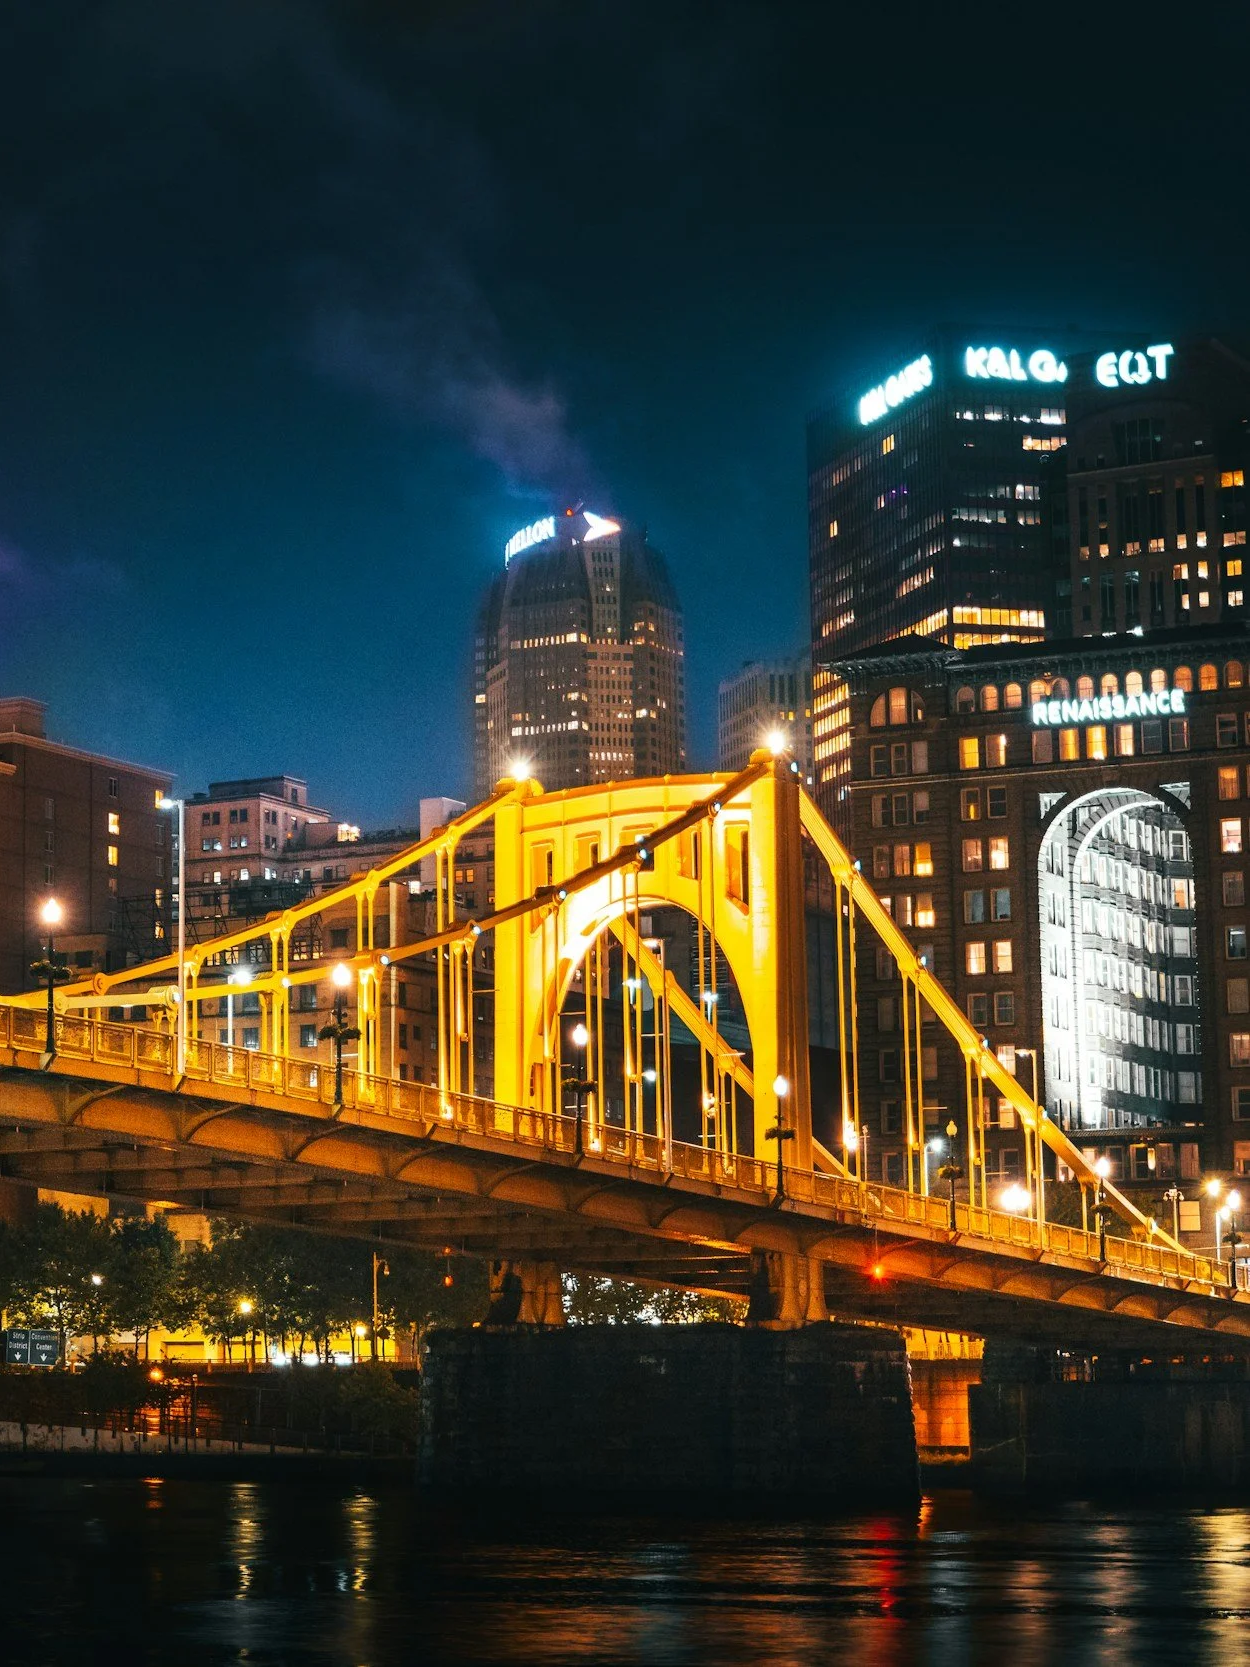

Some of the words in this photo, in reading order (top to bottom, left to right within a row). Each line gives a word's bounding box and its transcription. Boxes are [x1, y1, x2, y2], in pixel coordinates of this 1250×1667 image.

[1096, 344, 1173, 387] EQT
[1032, 688, 1185, 725] RENAISSANCE
[12, 1331, 25, 1340] Strip
[8, 1341, 28, 1350] District
[35, 1342, 52, 1350] Center
